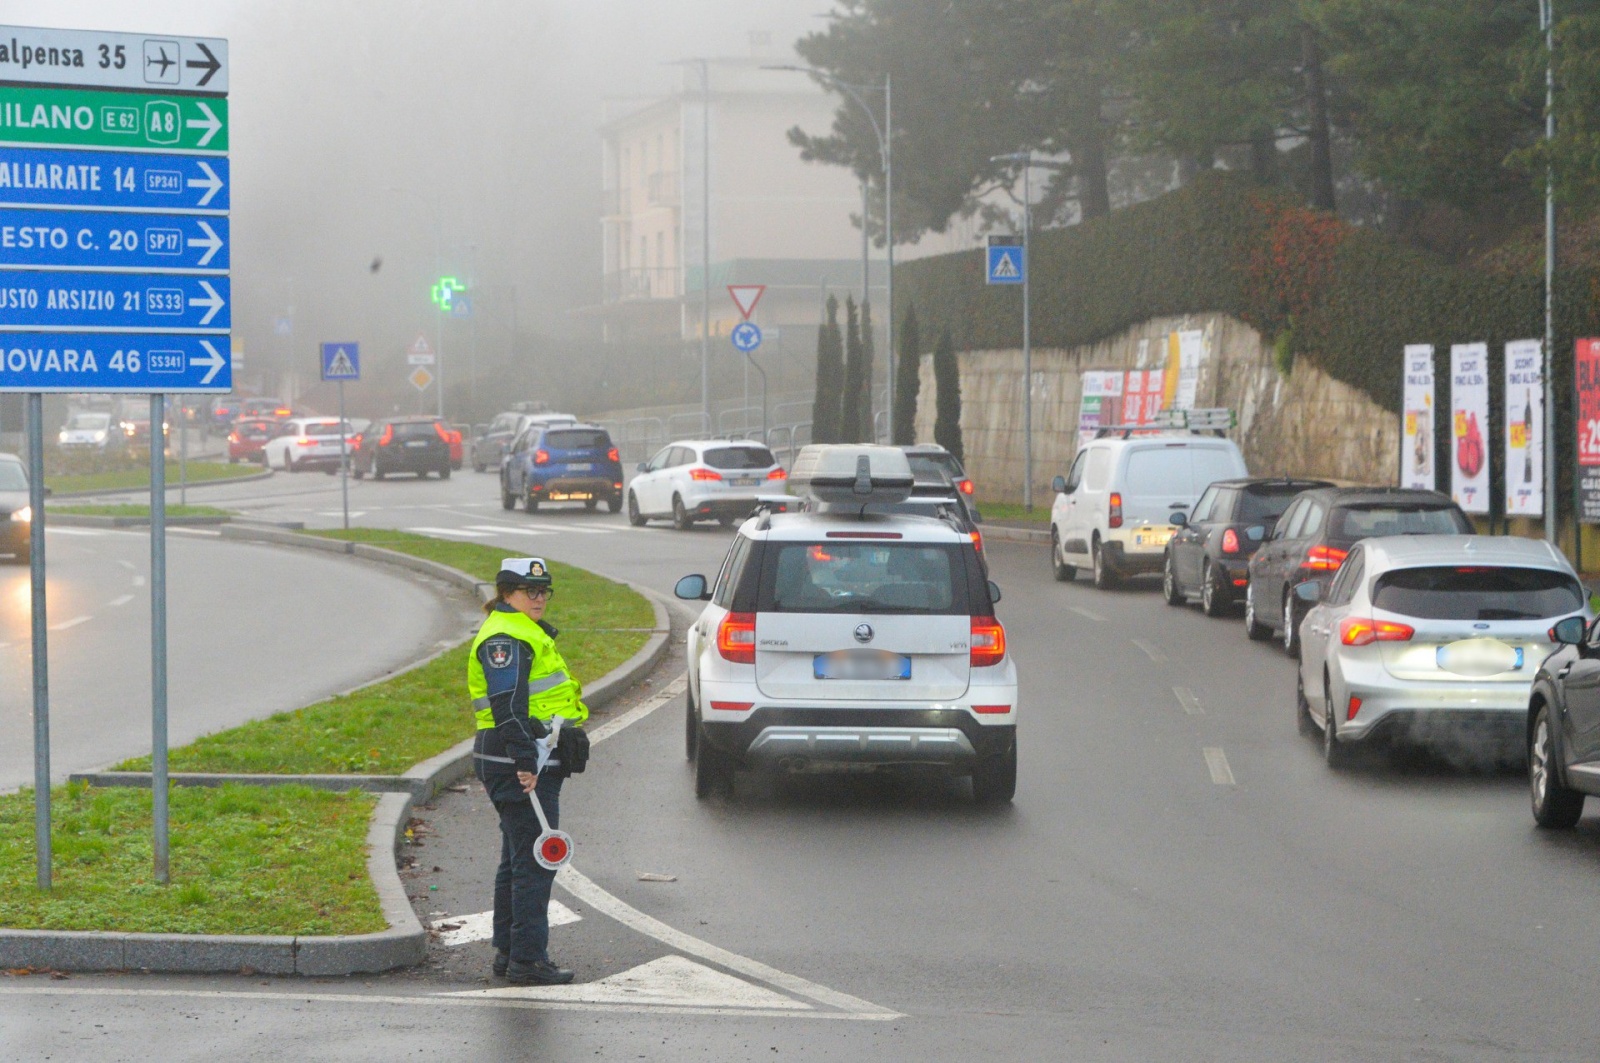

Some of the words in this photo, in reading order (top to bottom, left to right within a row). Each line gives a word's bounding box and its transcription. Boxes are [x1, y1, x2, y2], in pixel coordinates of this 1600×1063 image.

[0, 37, 85, 70] alpensa
[98, 43, 127, 70] 35
[0, 102, 94, 130] ILANO
[0, 161, 102, 191] ALLARATE
[113, 166, 136, 193] 14
[149, 175, 179, 189] SP341
[2, 226, 68, 249] ESTO
[77, 228, 100, 251] C.
[109, 229, 139, 251] 20
[149, 233, 179, 250] SP17
[46, 289, 115, 311] ARSIZIO
[123, 290, 141, 312] 21
[149, 293, 182, 311] SS33
[0, 348, 99, 373] OVARA
[108, 350, 142, 373] 46
[151, 355, 182, 369] SS341
